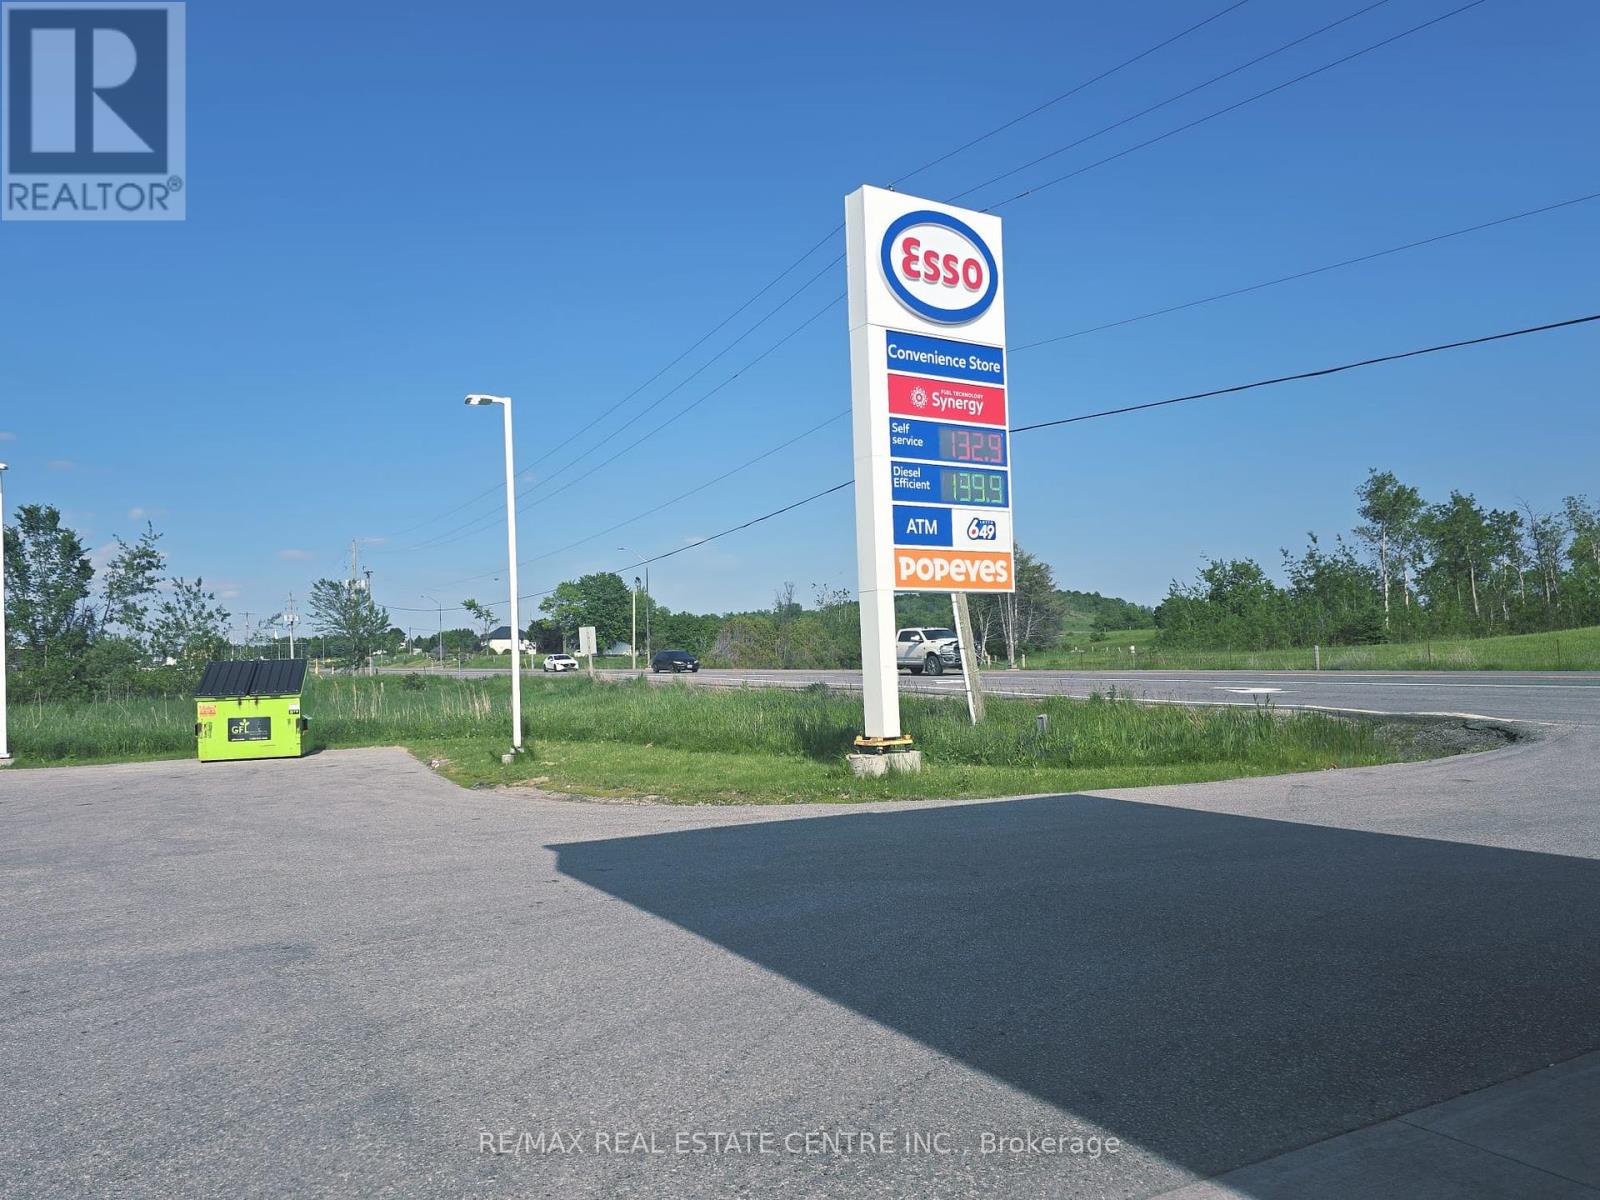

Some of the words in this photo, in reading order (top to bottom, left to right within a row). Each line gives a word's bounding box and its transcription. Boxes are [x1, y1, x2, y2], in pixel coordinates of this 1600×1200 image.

[887, 344, 966, 368] Convenience
[969, 356, 1001, 373] Store
[932, 392, 984, 415] Synergy
[892, 423, 910, 433] Self
[892, 435, 924, 447] service
[952, 431, 1002, 463] 132.9
[893, 466, 921, 478] Diesel
[893, 478, 931, 490] Efficient
[906, 518, 938, 535] ATM
